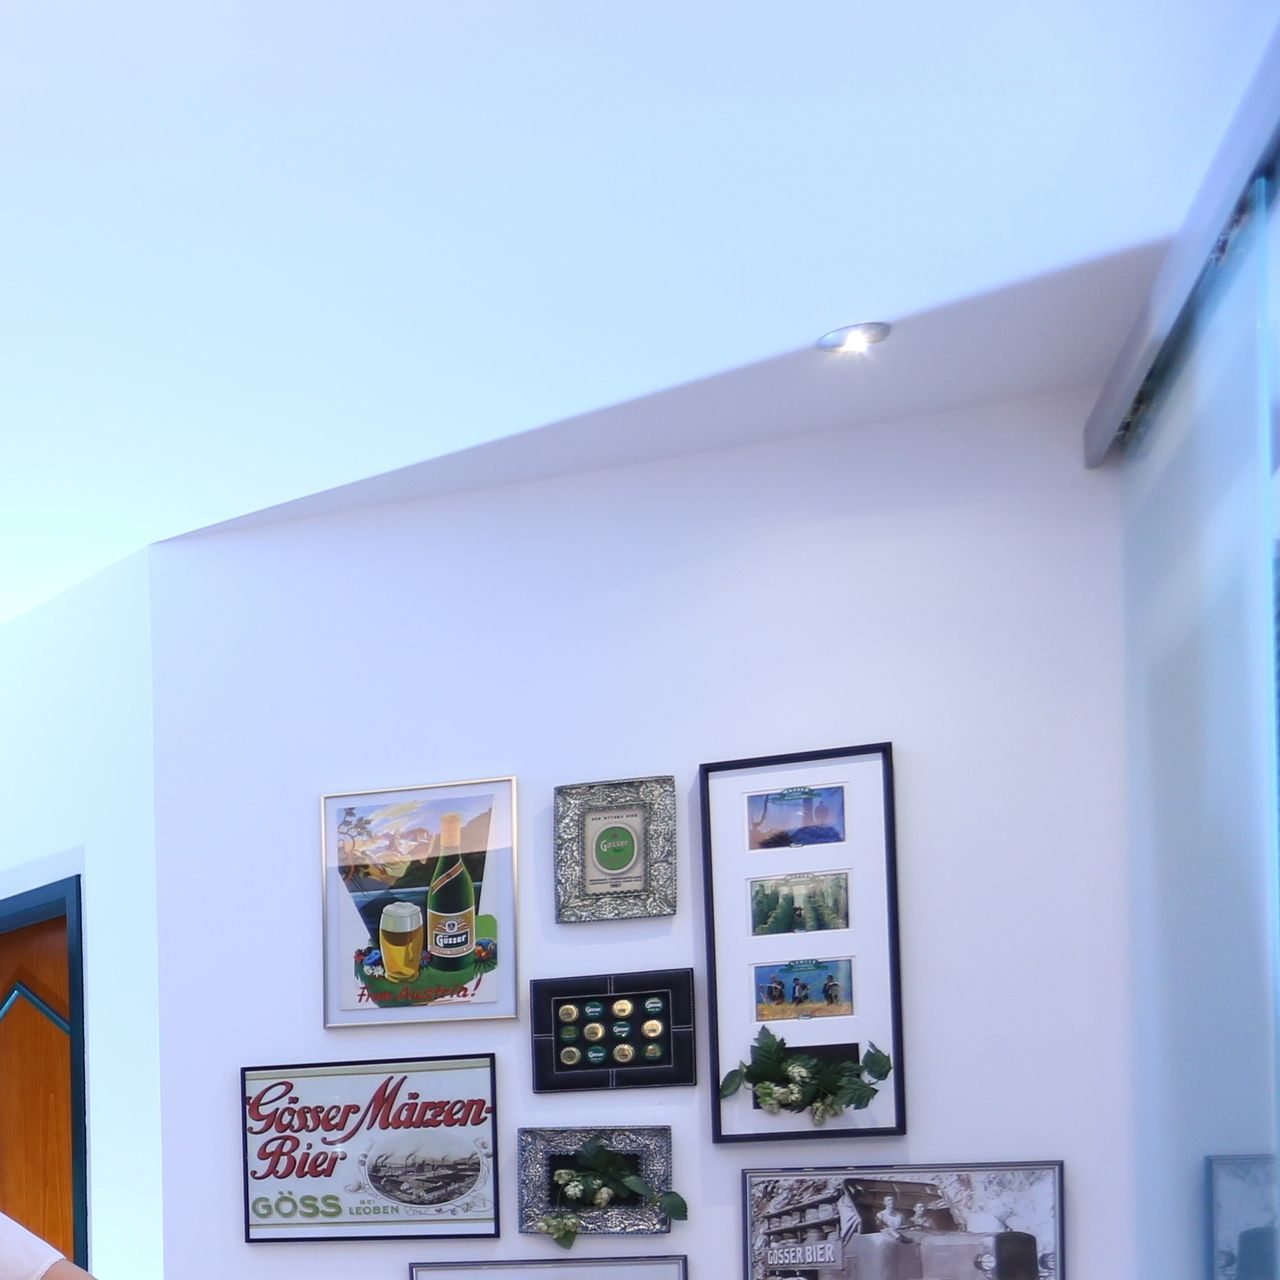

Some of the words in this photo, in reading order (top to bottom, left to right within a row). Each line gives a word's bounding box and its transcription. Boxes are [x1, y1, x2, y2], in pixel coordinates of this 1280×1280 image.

[246, 1080, 361, 1135] Gösser
[321, 1075, 494, 1145] Märzen-
[250, 1135, 347, 1180] Bier
[251, 1191, 342, 1218] GÖSS
[348, 1206, 400, 1216] LEOBEN
[805, 1244, 835, 1263] BIER
